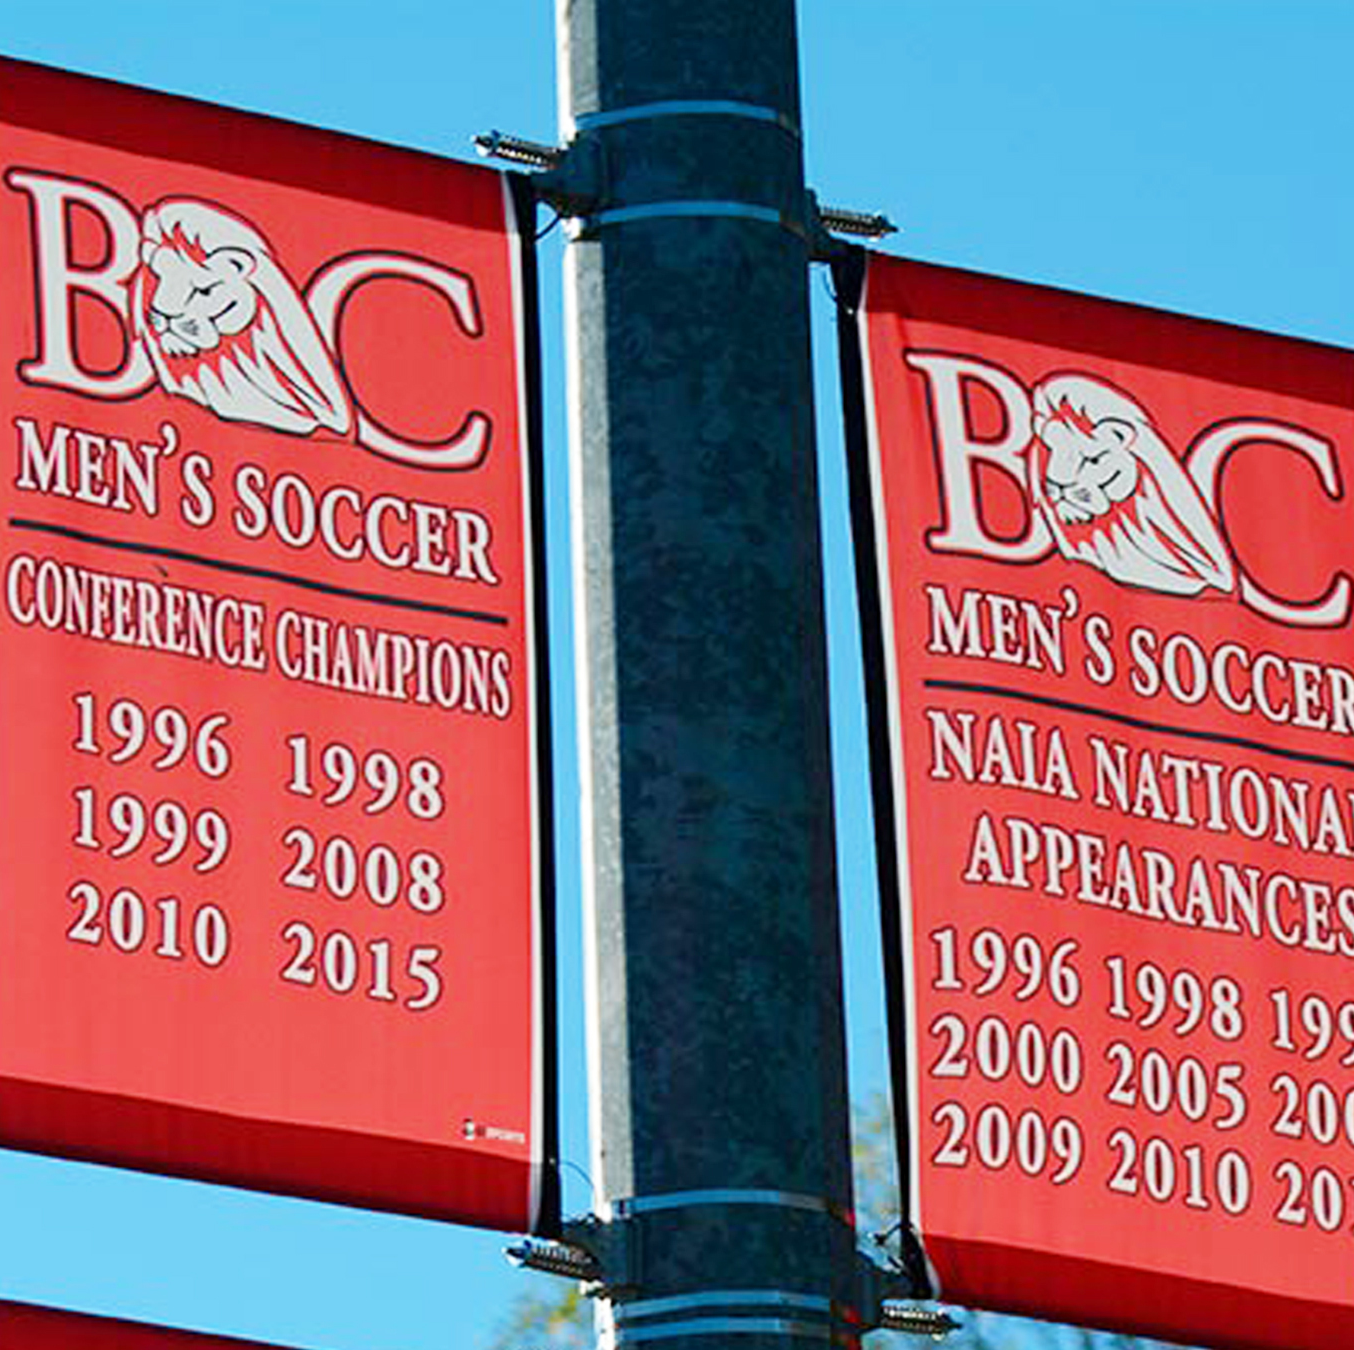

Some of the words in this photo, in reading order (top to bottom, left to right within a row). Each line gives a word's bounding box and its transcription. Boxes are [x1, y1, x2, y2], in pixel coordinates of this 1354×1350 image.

[15, 418, 214, 527] MEN’S
[233, 465, 499, 585] SOCCER
[6, 555, 267, 671] CONFERENCE
[275, 609, 511, 719] CHAMPIONS
[924, 584, 1115, 685] MEN’S
[74, 693, 230, 778] 1996
[288, 735, 444, 820] 1998
[925, 709, 1081, 801] NAIA
[74, 787, 229, 873] 1999
[283, 828, 443, 913] 2008
[67, 882, 228, 967] 2010
[281, 922, 441, 1010] 2015
[932, 927, 1080, 1007] 1996
[1106, 956, 1244, 1041] 1998
[930, 1014, 1082, 1095] 2000
[1106, 1041, 1247, 1130] 2005
[933, 1102, 1083, 1184] 2009
[1108, 1129, 1250, 1215] 2010
